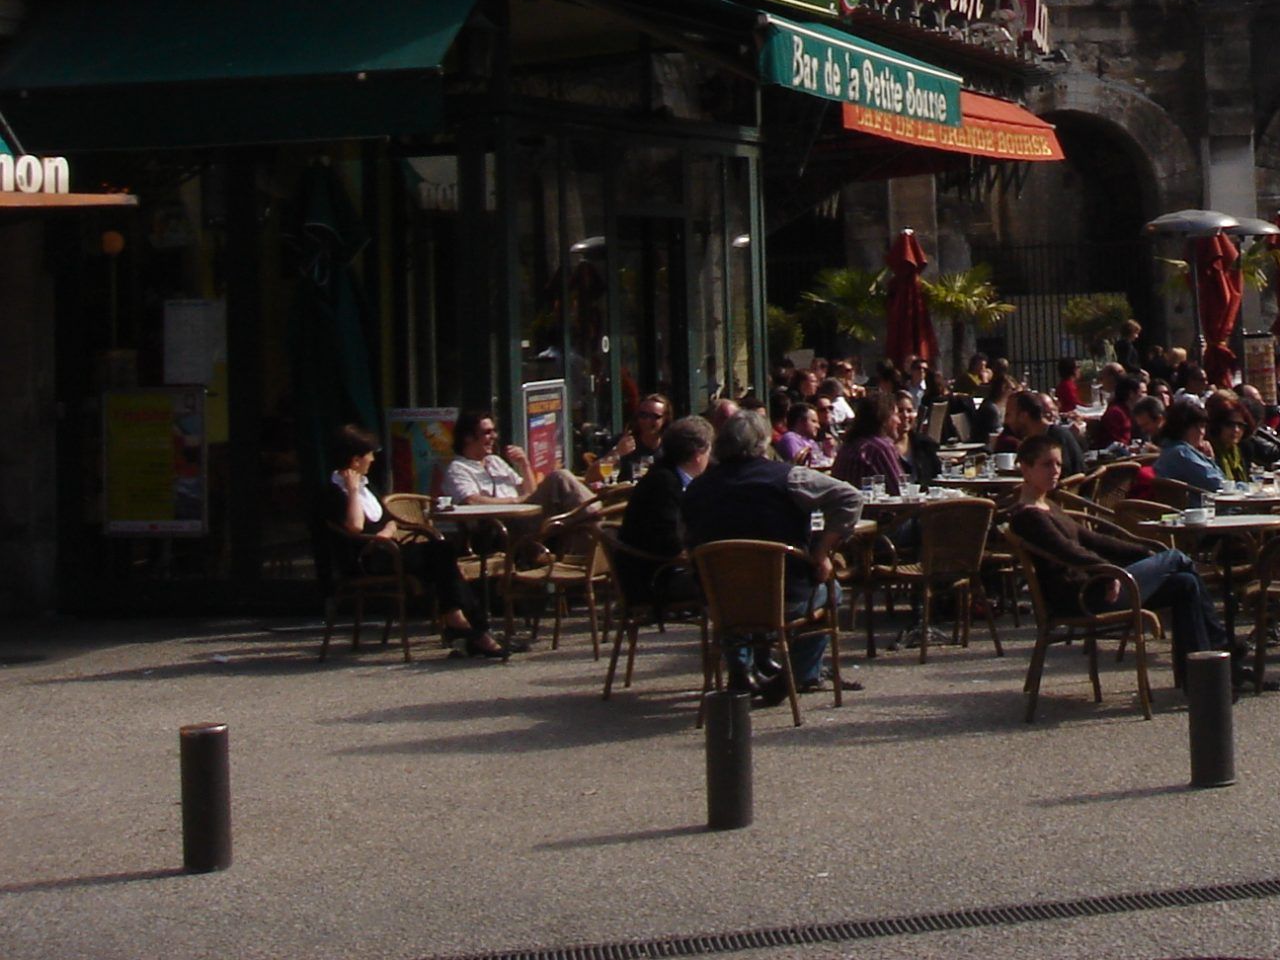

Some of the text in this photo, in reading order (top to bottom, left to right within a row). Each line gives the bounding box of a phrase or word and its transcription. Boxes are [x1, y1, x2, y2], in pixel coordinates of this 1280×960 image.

[792, 35, 819, 90] Bar
[824, 47, 842, 97] de
[862, 58, 904, 113] Petite
[998, 130, 1053, 156] BOURSE
